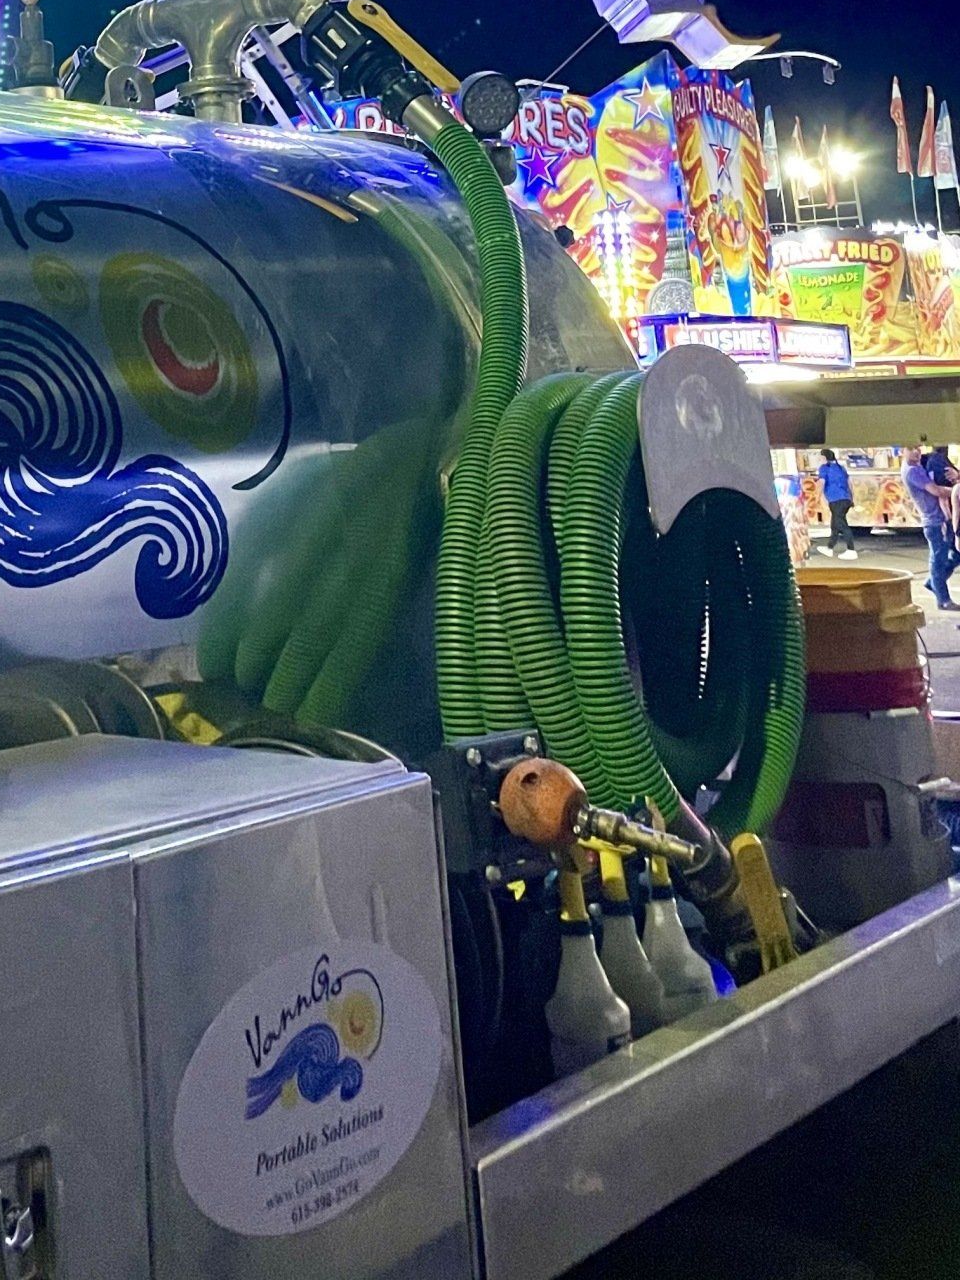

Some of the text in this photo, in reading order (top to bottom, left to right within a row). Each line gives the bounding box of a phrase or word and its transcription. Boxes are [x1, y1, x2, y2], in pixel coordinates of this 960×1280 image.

[674, 86, 702, 121] GUILTY
[837, 240, 893, 263] FRIED
[798, 272, 859, 289] LEMONADE
[256, 1106, 384, 1176] Portable Solutions
